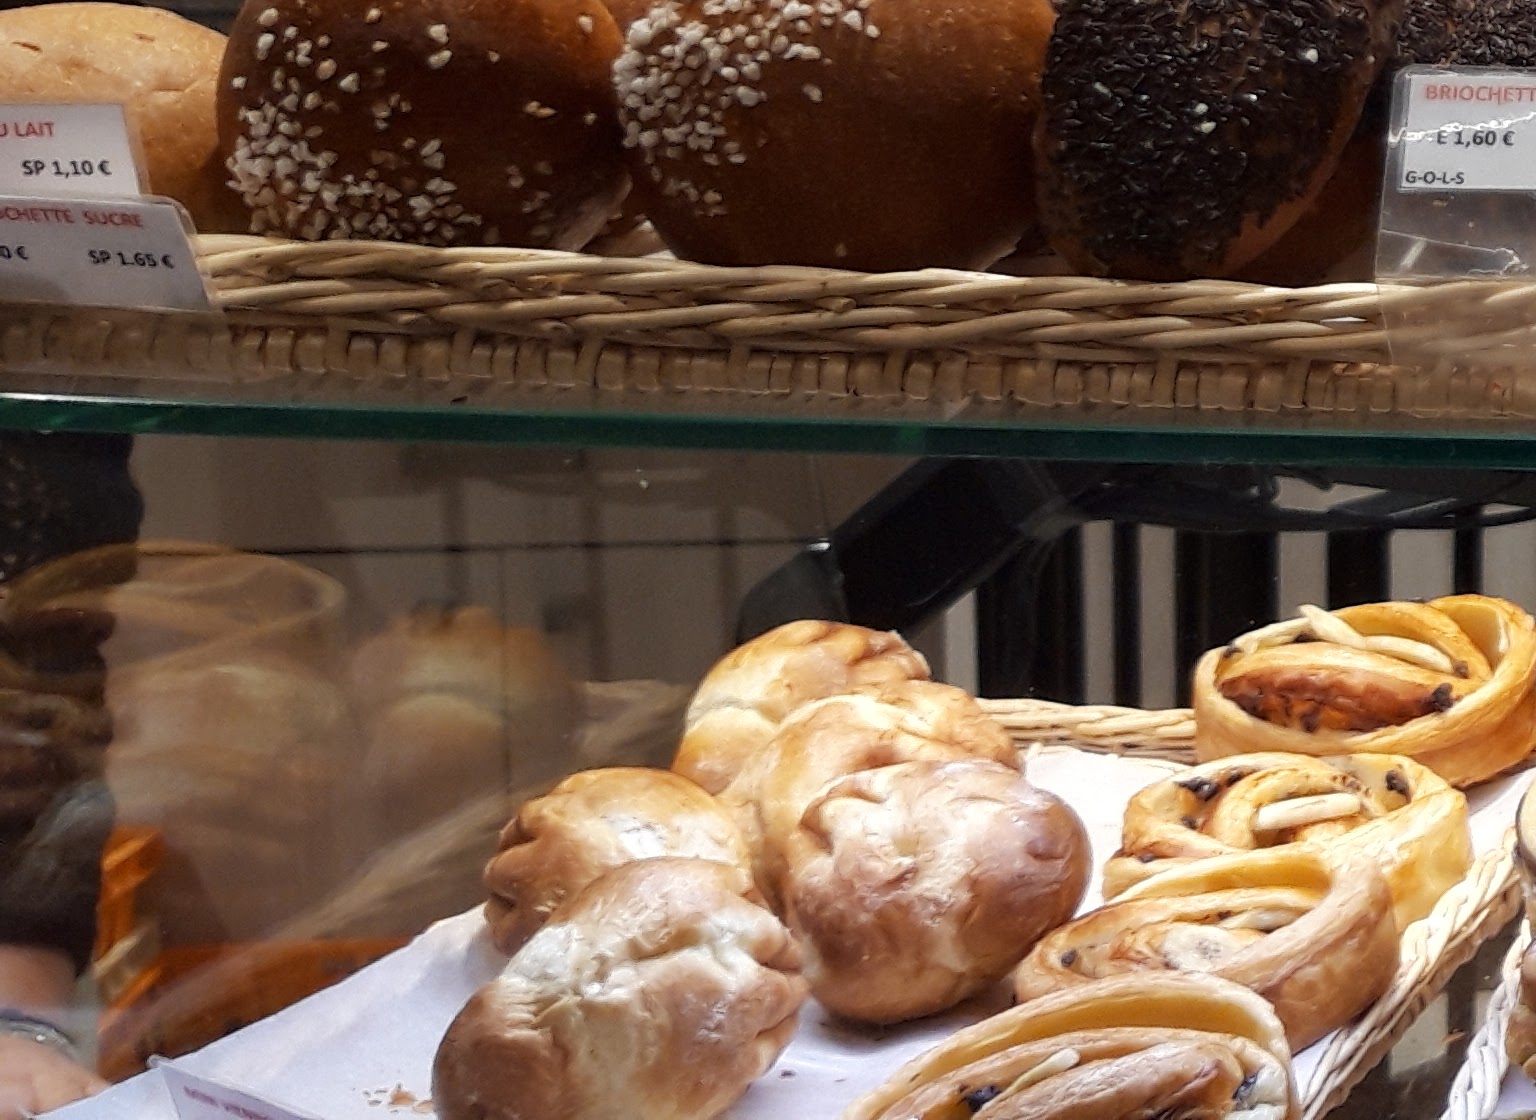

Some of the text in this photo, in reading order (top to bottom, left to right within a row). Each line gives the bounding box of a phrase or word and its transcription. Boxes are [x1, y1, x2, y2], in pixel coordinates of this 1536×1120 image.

[14, 122, 54, 137] LAIT
[1454, 130, 1496, 148] 1,60
[1503, 130, 1515, 146] €
[21, 160, 113, 179] SP 1,10 €
[1405, 170, 1465, 185] G-O-L-S
[82, 210, 143, 227] SUCRE
[88, 250, 111, 264] SP
